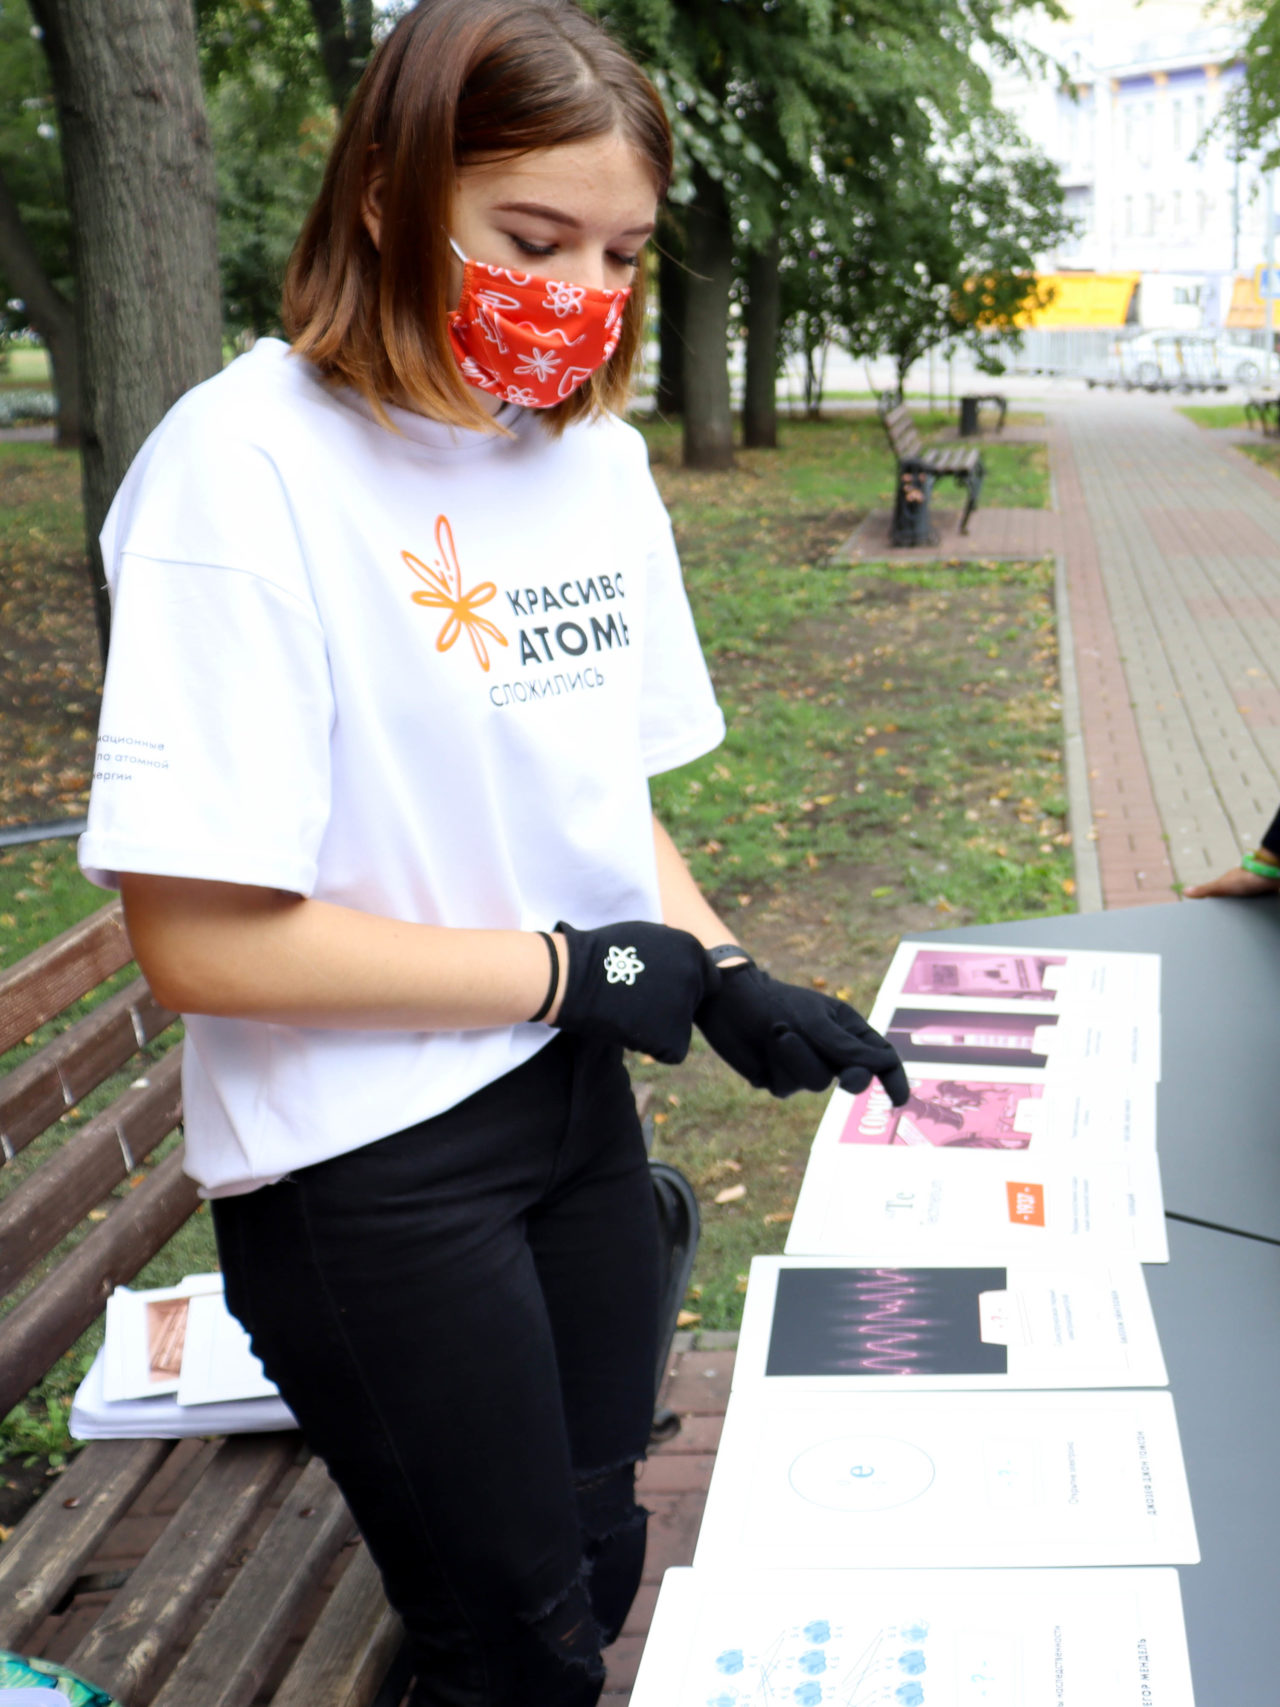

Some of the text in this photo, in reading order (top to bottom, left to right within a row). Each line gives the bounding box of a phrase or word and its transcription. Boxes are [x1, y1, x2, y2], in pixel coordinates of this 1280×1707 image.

[489, 667, 605, 707] СЛОЖИЛИСЬ
[114, 753, 170, 769] атомной
[1141, 1461, 1152, 1483] ДЖОН
[1137, 1638, 1151, 1681] МЕНДЕЛЬ
